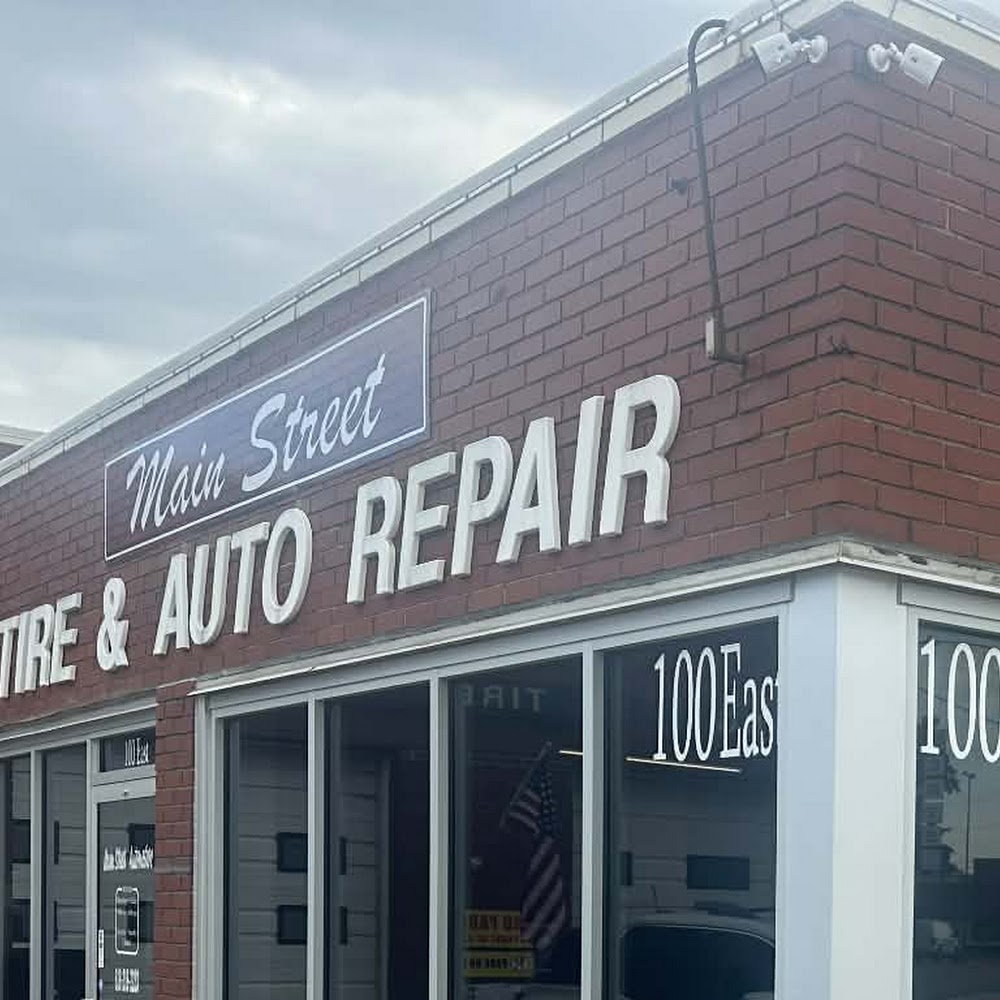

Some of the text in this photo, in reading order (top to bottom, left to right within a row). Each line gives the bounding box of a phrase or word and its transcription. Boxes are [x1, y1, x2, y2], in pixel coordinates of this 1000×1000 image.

[0, 374, 682, 699] TIRE & AUTO REPAIR
[126, 353, 386, 533] Main Street
